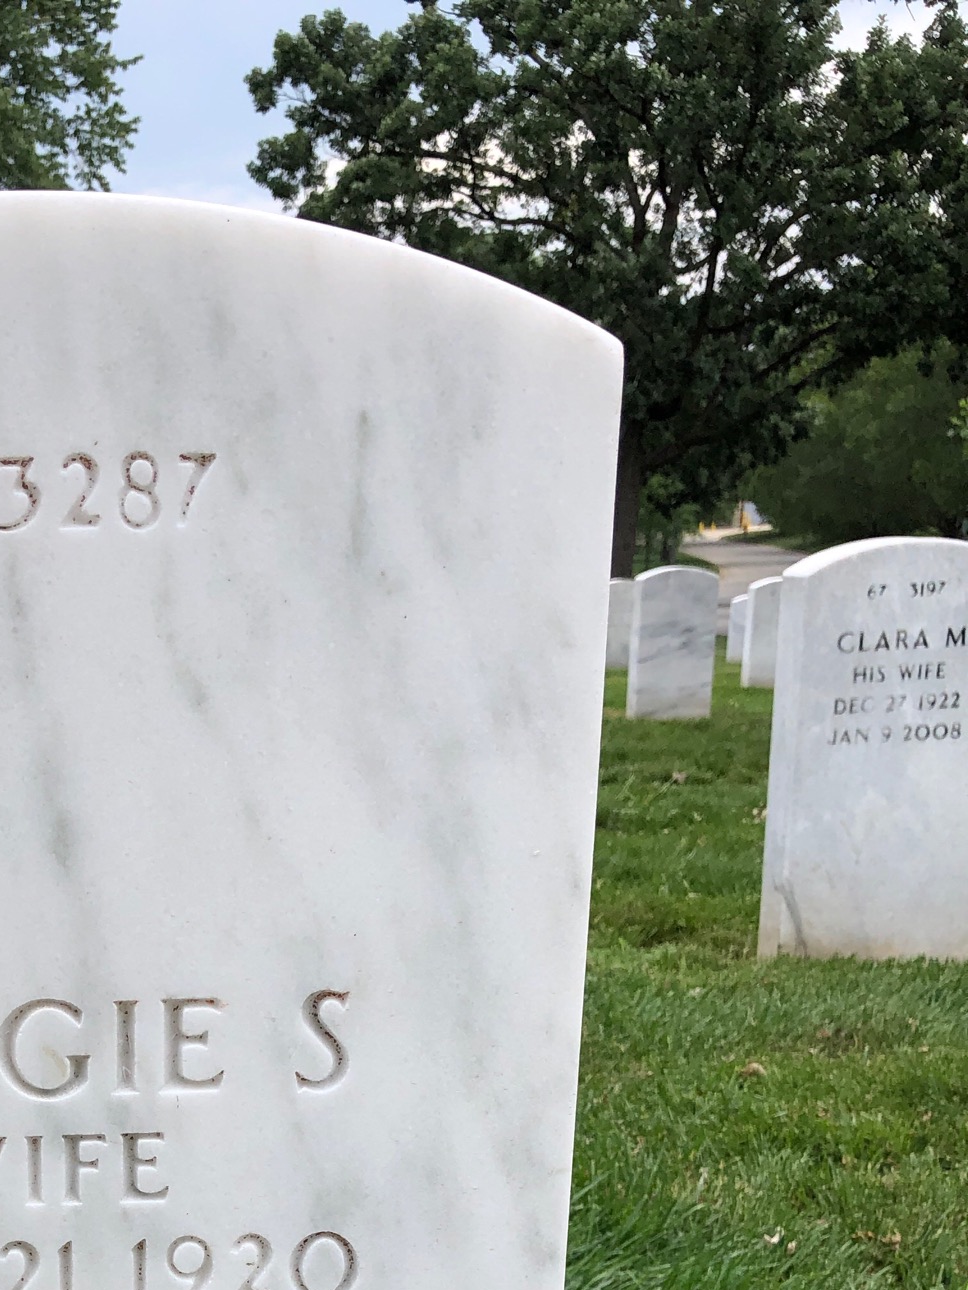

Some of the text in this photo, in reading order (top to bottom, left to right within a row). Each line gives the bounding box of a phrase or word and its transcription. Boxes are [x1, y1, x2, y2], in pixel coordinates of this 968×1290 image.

[867, 581, 946, 600] 67 3197
[837, 627, 966, 654] CLARA M
[853, 662, 946, 684] HIS WIFE
[834, 691, 960, 715] DEC 27 1922
[827, 722, 962, 745] JAN 9 2008
[294, 988, 350, 1093] S
